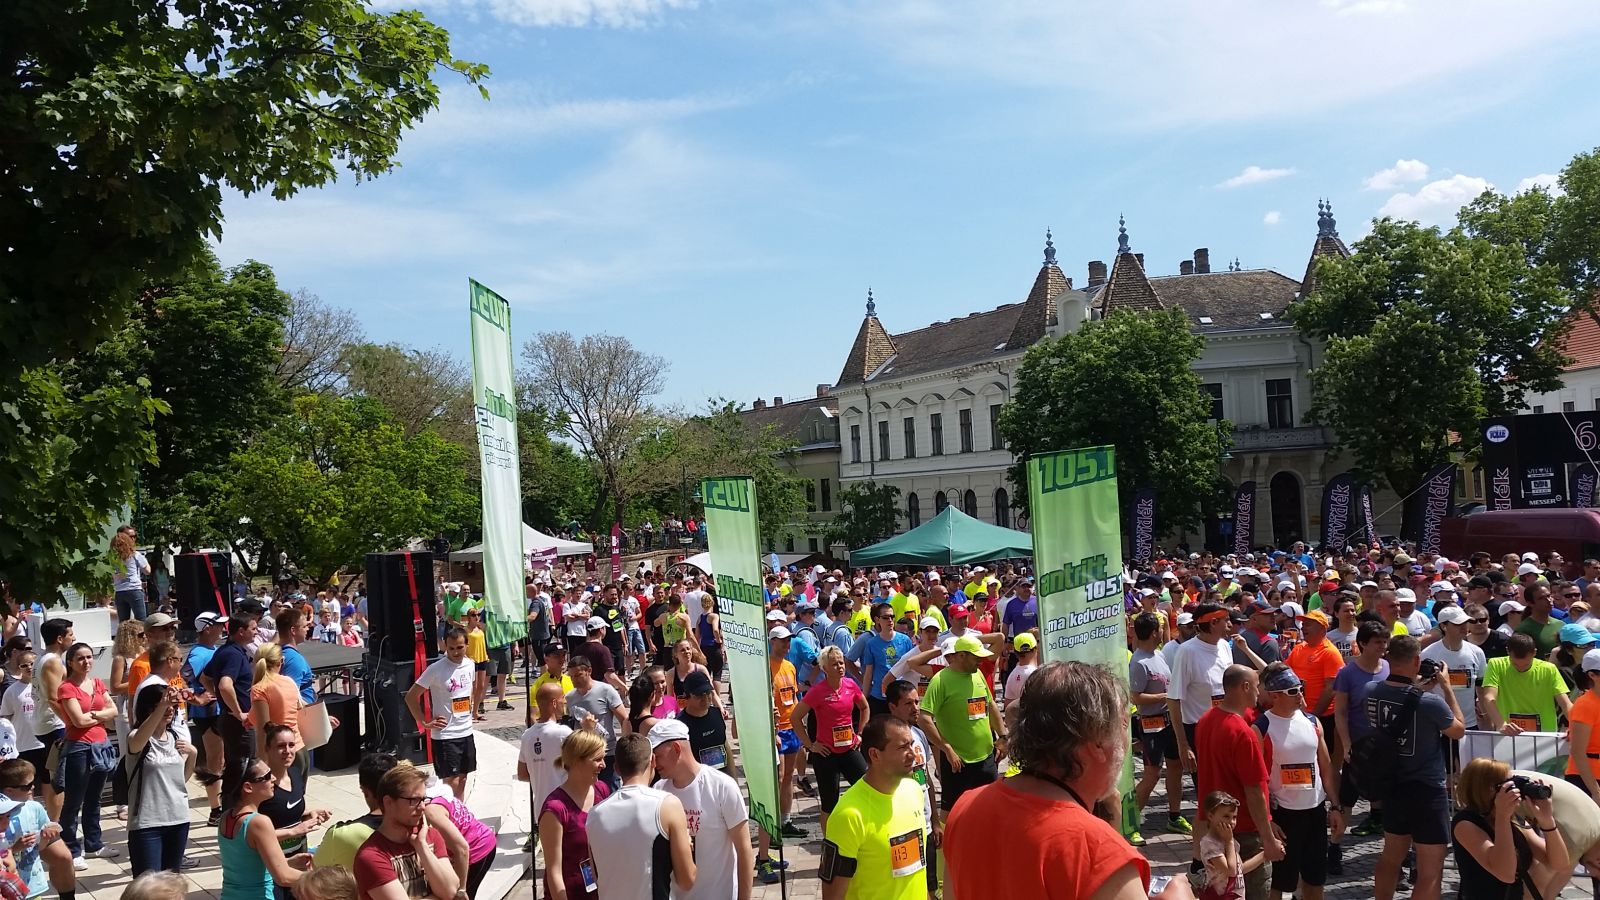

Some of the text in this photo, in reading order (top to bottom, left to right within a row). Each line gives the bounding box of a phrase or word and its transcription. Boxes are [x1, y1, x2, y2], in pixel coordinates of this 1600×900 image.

[1039, 448, 1117, 494] 105.1
[1327, 508, 1335, 547] LMARATON
[1330, 484, 1350, 550] orvidék
[1040, 554, 1107, 597] antritt
[1048, 617, 1066, 633] ma
[1059, 632, 1089, 648] tegnap
[1336, 641, 1351, 649] Die
[894, 846, 908, 862] 113
